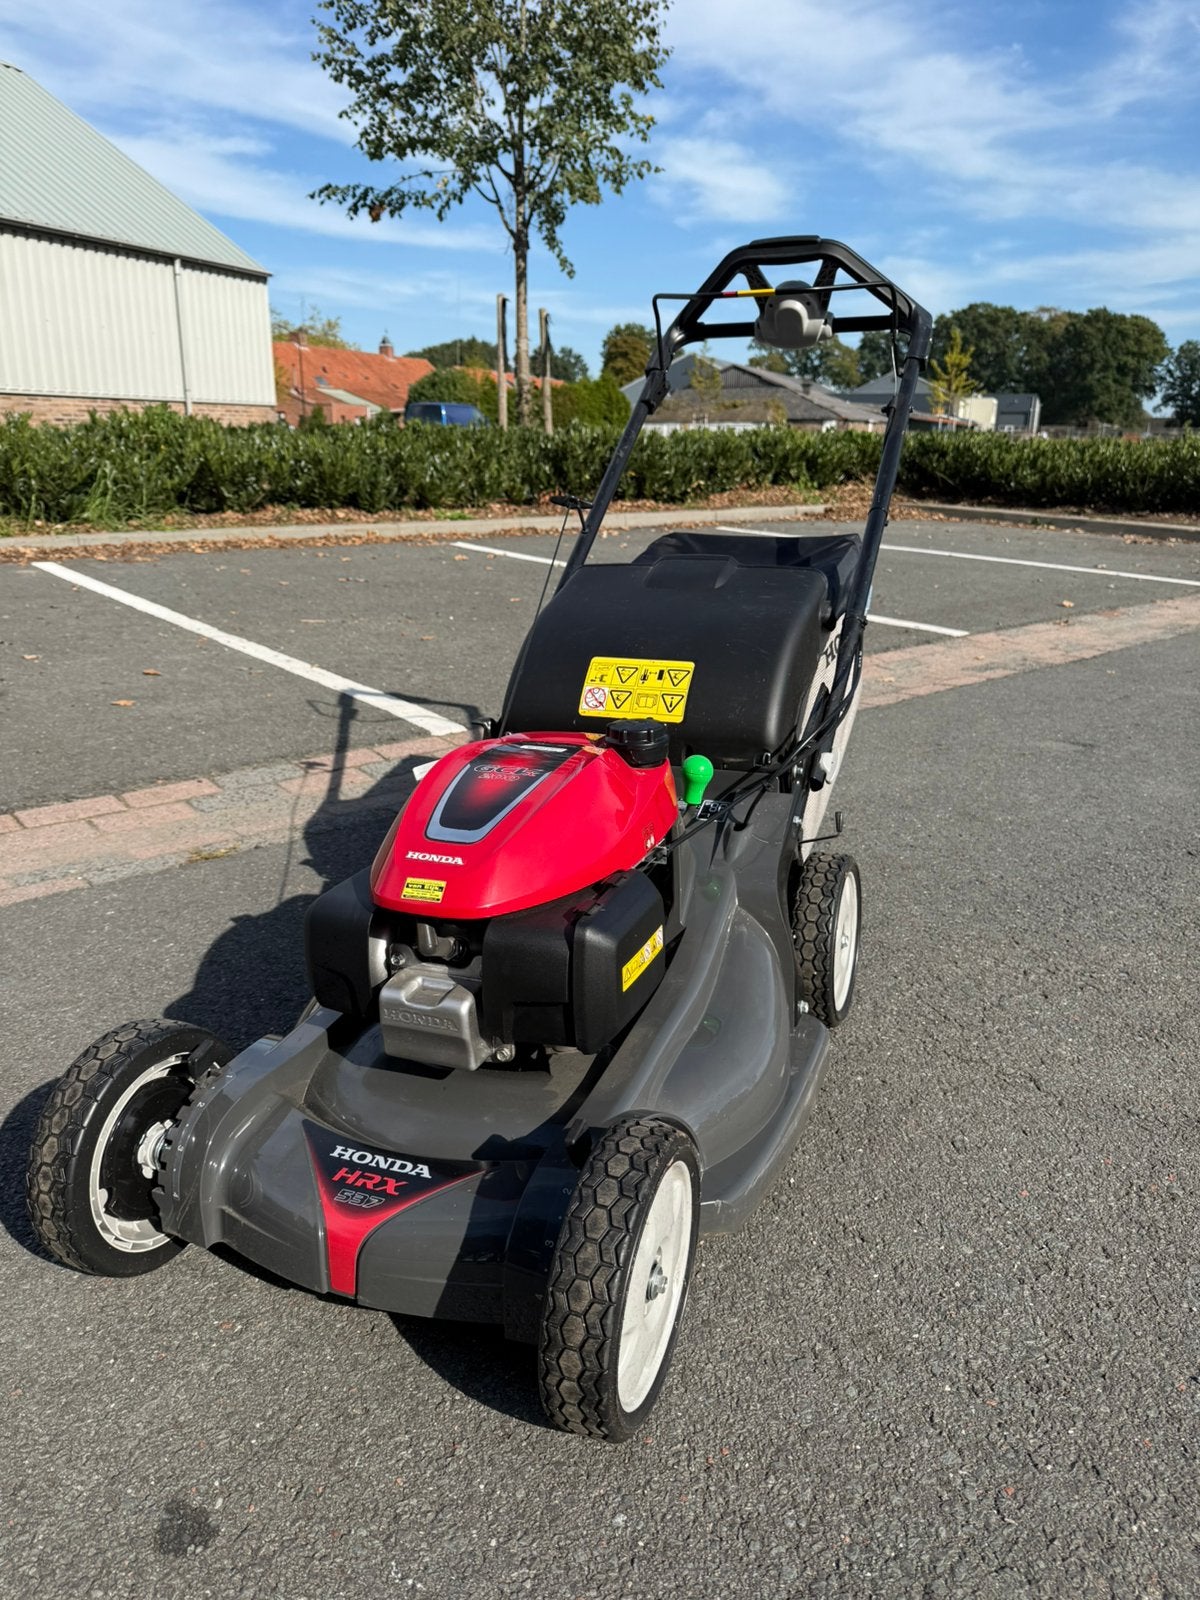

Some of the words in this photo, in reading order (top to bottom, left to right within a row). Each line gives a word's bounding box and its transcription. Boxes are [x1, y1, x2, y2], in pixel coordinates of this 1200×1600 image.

[405, 851, 464, 865] HONDA
[383, 1008, 458, 1032] HONDA
[329, 1145, 432, 1179] HONDA
[332, 1167, 408, 1196] HRX
[334, 1189, 385, 1209] 537
